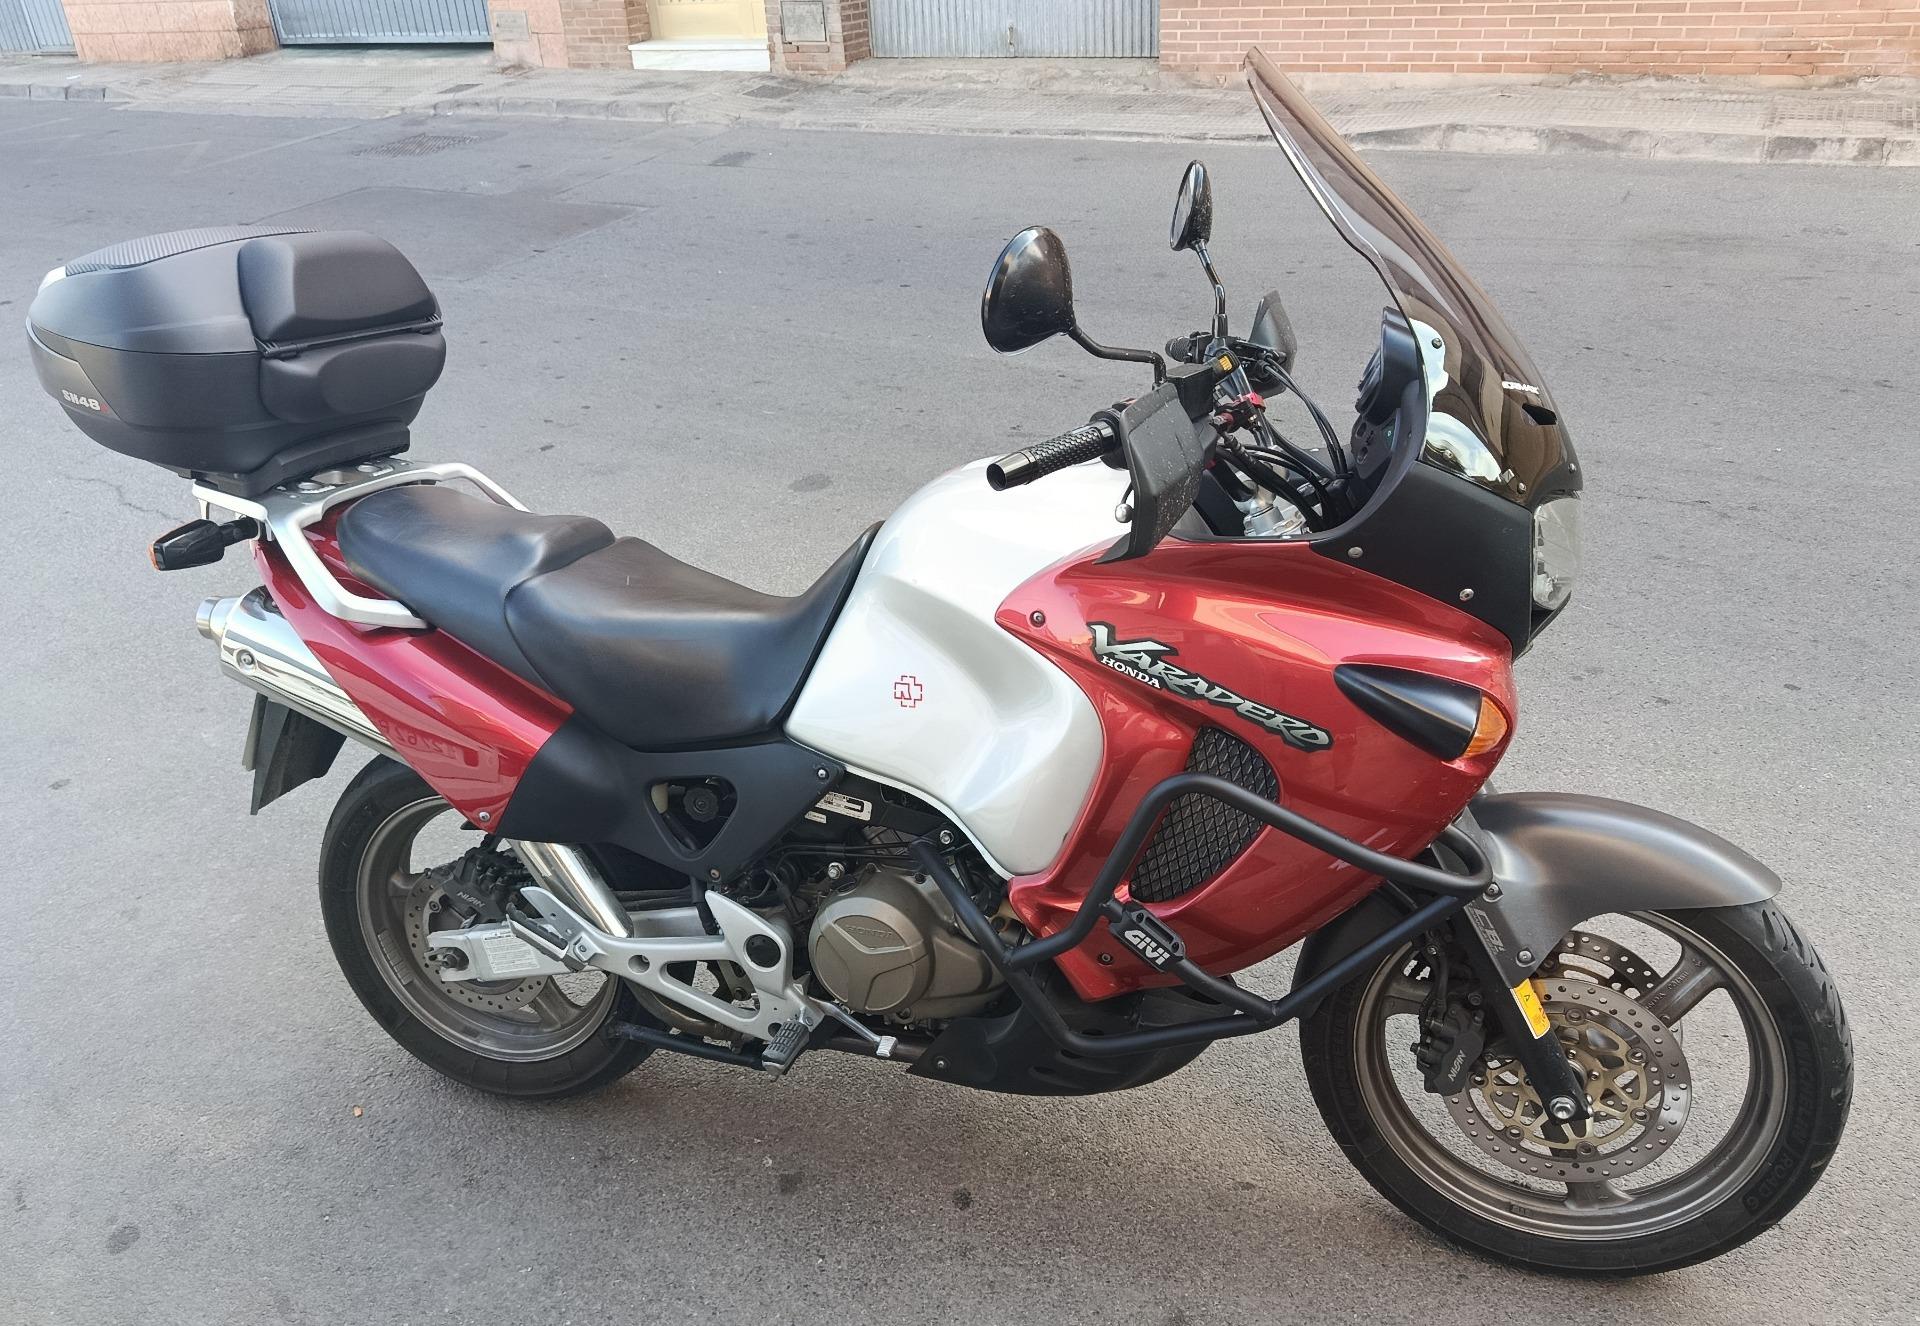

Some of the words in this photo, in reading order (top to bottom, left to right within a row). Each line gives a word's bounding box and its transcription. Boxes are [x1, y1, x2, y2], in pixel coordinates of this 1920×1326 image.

[61, 389, 101, 411] SH48
[1089, 623, 1332, 748] VARADERO
[1100, 655, 1162, 690] HONDA
[1124, 929, 1171, 966] GIVI
